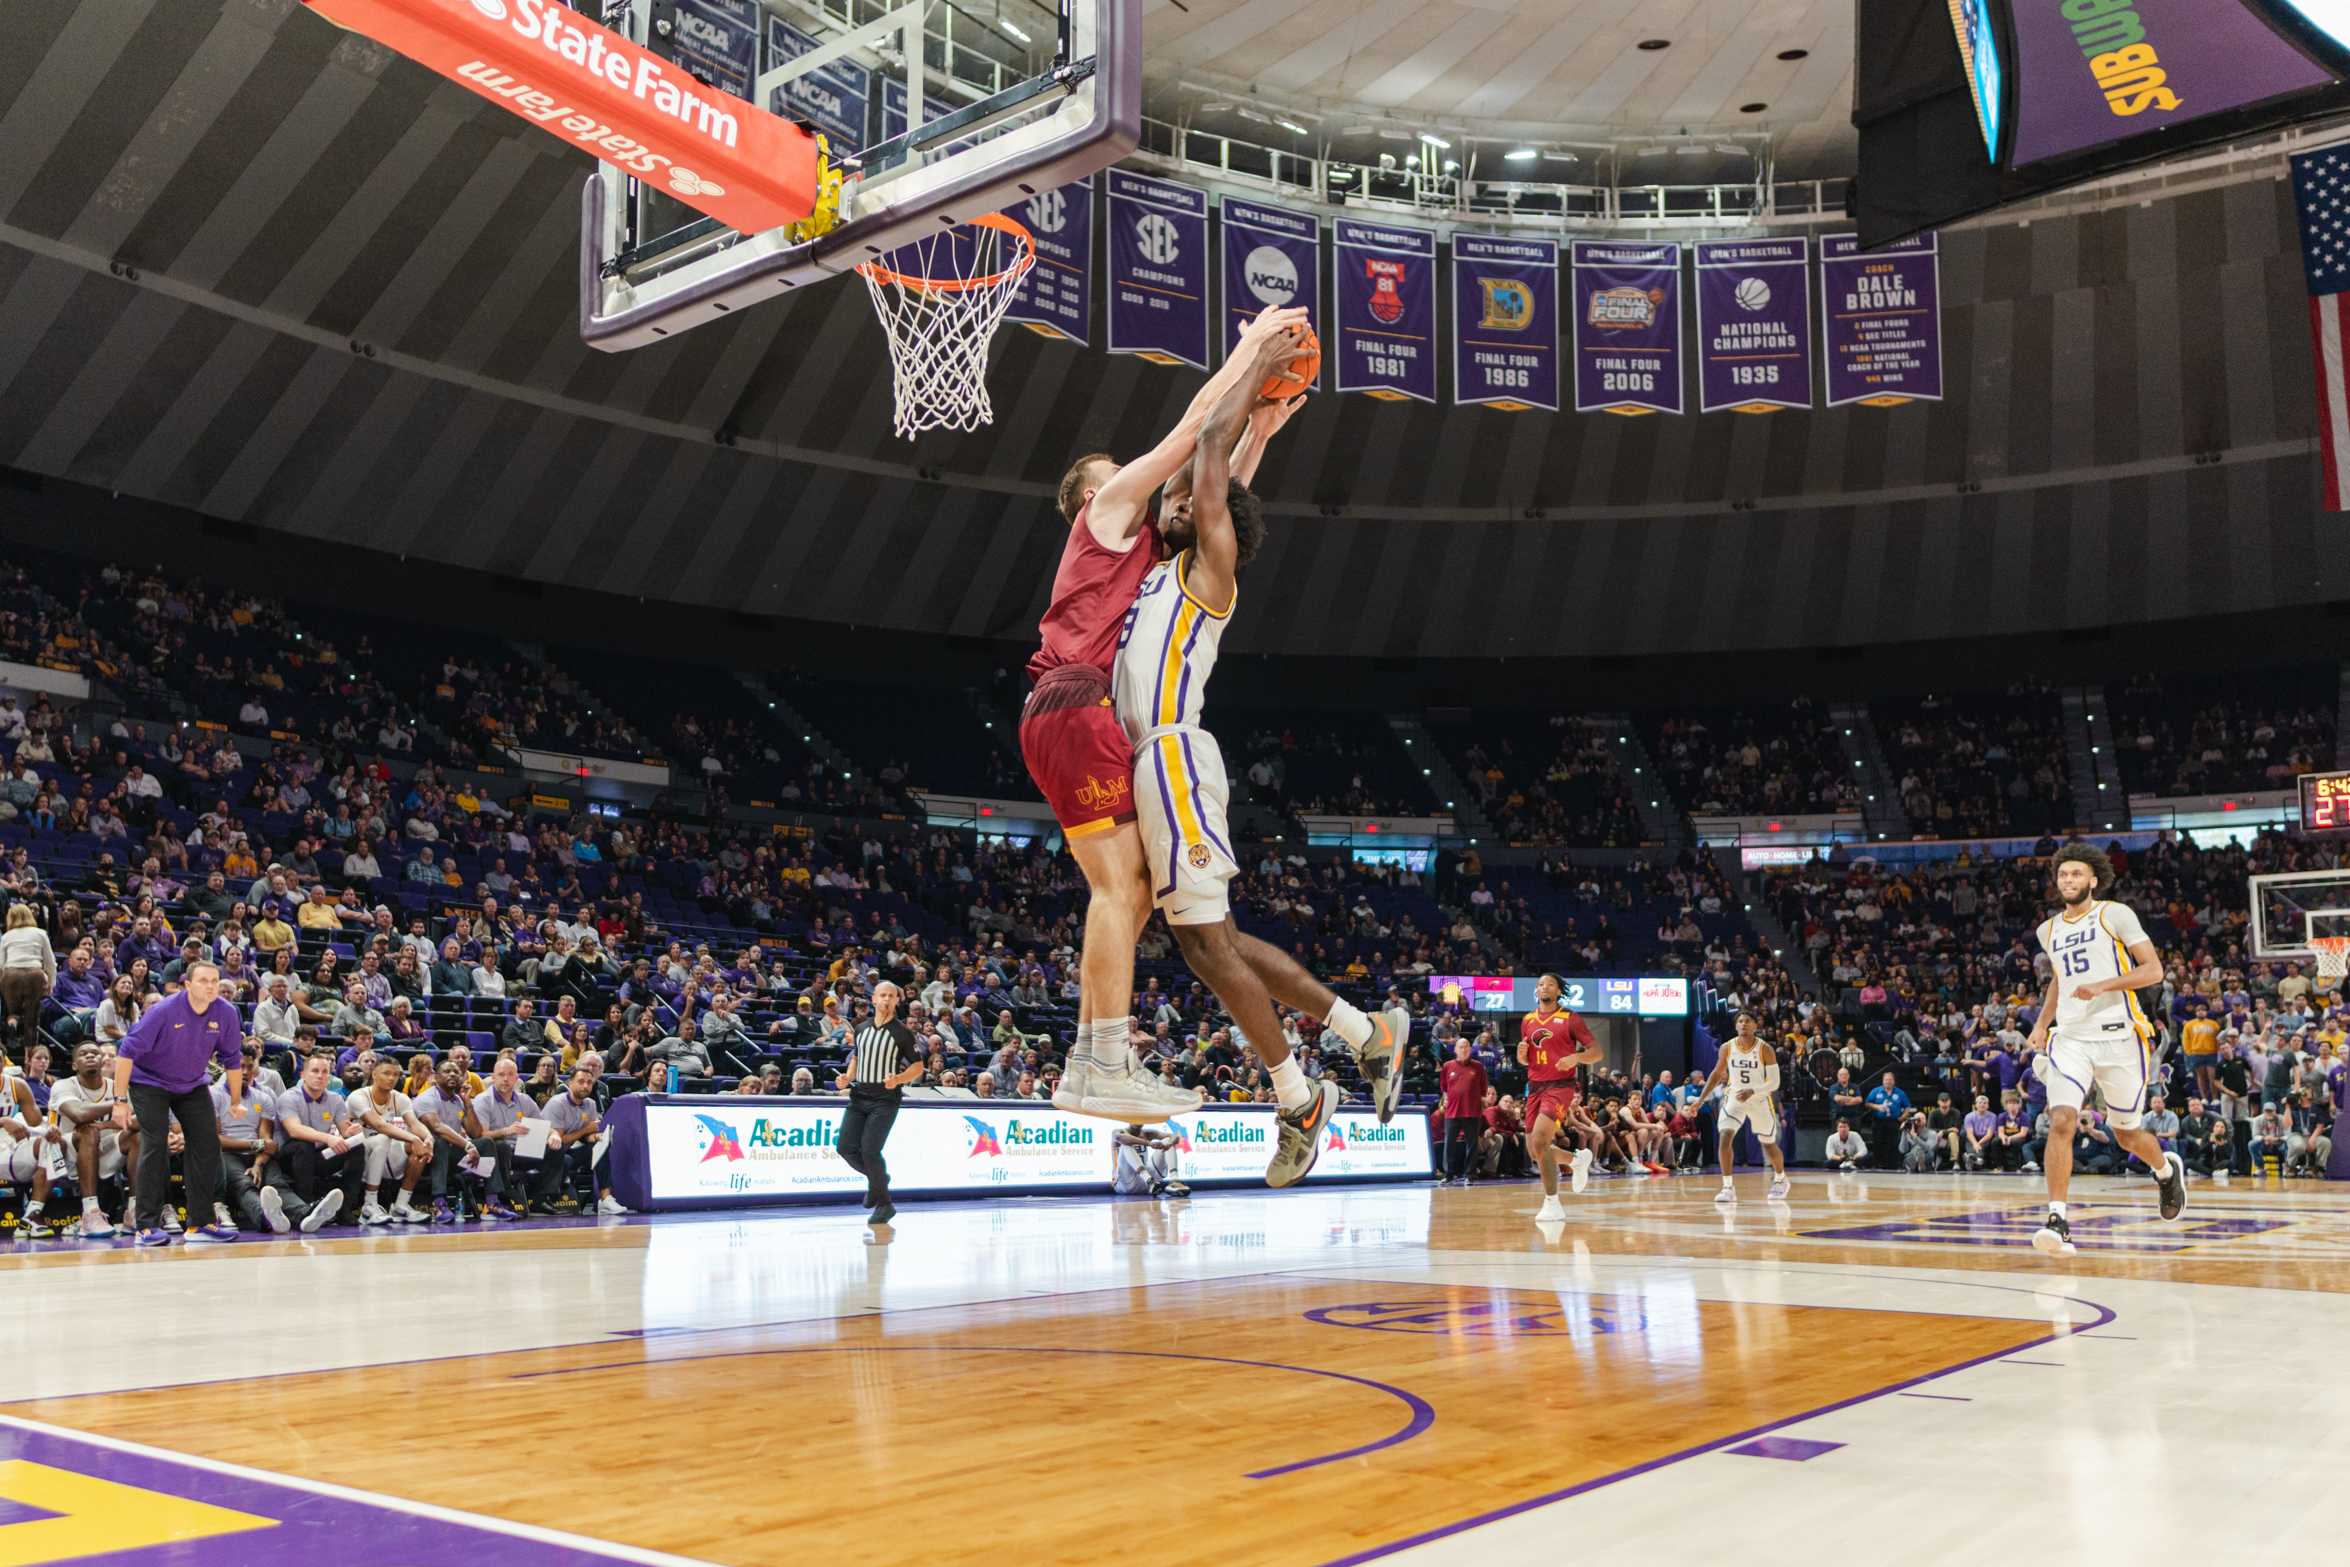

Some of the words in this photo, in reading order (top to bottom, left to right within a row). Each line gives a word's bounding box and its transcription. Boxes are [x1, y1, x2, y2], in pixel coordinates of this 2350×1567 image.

[1025, 188, 1067, 233] SEC
[1136, 213, 1180, 264] SEC
[1132, 267, 1185, 287] CHAMPIONS
[1251, 272, 1297, 294] NCAA
[1857, 274, 1904, 292] DALE
[1846, 289, 1917, 310] BROWN
[1594, 306, 1647, 320] FOUR
[1720, 321, 1788, 337] NATIONAL
[1355, 339, 1387, 354] FINAL
[1389, 345, 1417, 358] FOUR
[1713, 334, 1797, 351] CHAMPIONS
[1368, 356, 1406, 378] 1981
[1474, 352, 1506, 366] FINAL
[1509, 354, 1539, 368] FOUR
[1595, 357, 1628, 370] FINAL
[1631, 358, 1661, 371] FOUR
[1484, 367, 1529, 388] 1986
[1603, 373, 1654, 391] 2006
[1731, 365, 1780, 385] 1935
[2053, 927, 2096, 953] LSU
[2062, 948, 2090, 977] 15
[1606, 980, 1633, 992] LSU
[1484, 993, 1504, 1009] 27
[1609, 994, 1633, 1010] 84
[1536, 1049, 1548, 1065] 14
[1731, 1059, 1758, 1069] LSU
[1740, 1070, 1750, 1084] 5
[748, 1118, 840, 1148] Acadia
[1005, 1119, 1093, 1145] Acadian
[1194, 1120, 1265, 1143] Acadian
[1348, 1121, 1405, 1142] Acadian
[749, 1149, 817, 1162] Ambulance
[1005, 1146, 1058, 1157] Ambulance
[1060, 1145, 1095, 1156] Service
[729, 1172, 751, 1193] life
[991, 1167, 1009, 1184] life
